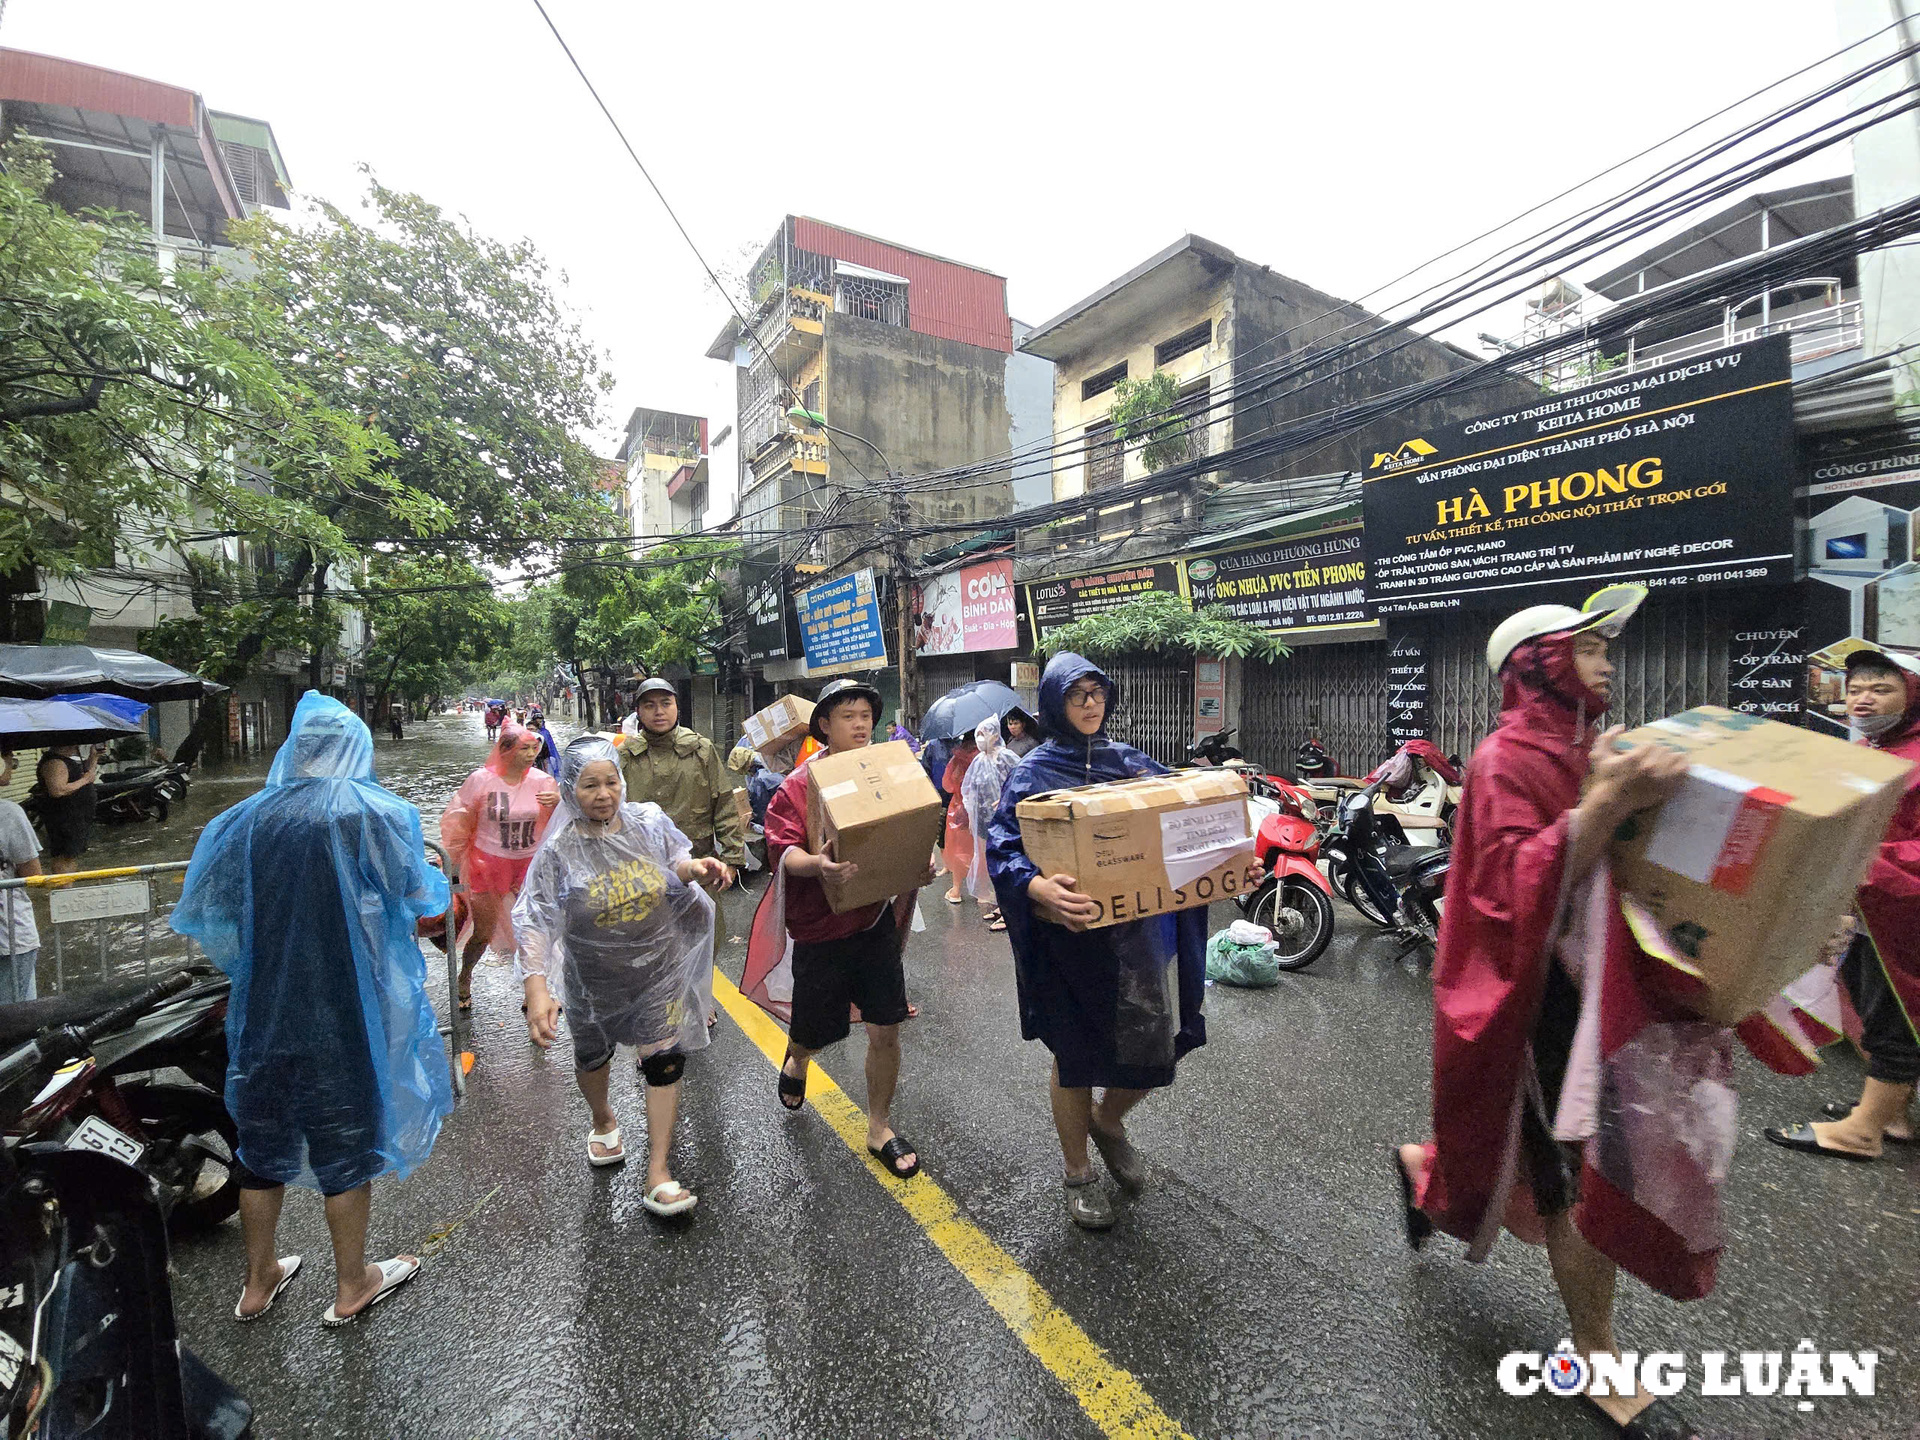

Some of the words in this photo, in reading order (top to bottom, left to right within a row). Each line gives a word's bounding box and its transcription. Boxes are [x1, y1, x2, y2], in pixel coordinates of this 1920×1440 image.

[1465, 418, 1499, 435] CÔNG
[1502, 412, 1519, 425] TY
[1521, 400, 1562, 420] TNHH
[1563, 384, 1630, 411] THƯƠNG
[1632, 373, 1665, 393] MẠI
[1668, 363, 1711, 381] DỊCH
[1714, 353, 1742, 369] VỤ
[1537, 411, 1584, 433] KEITA
[1586, 397, 1641, 420] HOME
[1416, 471, 1439, 484] VĂN
[1440, 462, 1482, 480] PHÒNG
[1483, 457, 1506, 471] ĐẠI
[1507, 449, 1540, 466] DIỆN
[1541, 436, 1595, 457] THÀNH
[1598, 424, 1631, 445] PHỐ
[1634, 420, 1660, 436] HÀ
[1663, 413, 1695, 431] NỘI
[1383, 461, 1403, 471] KEITA
[1404, 456, 1425, 466] HOME
[1815, 463, 1867, 479] CÔNG
[1437, 487, 1491, 525] HÀ
[1503, 457, 1664, 514] PHONG
[1406, 533, 1422, 545] TƯ
[1423, 528, 1448, 542] VẤN,
[1449, 522, 1483, 539] THIẾT
[1485, 517, 1504, 532] KẾ,
[1506, 516, 1529, 530] THI
[1531, 510, 1571, 525] CÔNG
[1573, 504, 1600, 518] NỘI
[1603, 494, 1644, 514] THẤT
[1647, 489, 1692, 506] TRỌN
[1694, 481, 1727, 498] GÓI
[1241, 552, 1272, 567] HÀNG
[1273, 543, 1321, 561] PHƯƠNG
[1324, 537, 1360, 554] HÙNG
[1378, 557, 1390, 566] THI
[1392, 553, 1417, 564] CÔNG
[1477, 540, 1506, 551] NANO
[1472, 555, 1497, 566] VÁCH
[1500, 550, 1536, 563] TRANG
[1538, 545, 1556, 557] TRÍ
[1559, 545, 1574, 555] TV
[1379, 580, 1407, 590] TRANH
[1408, 578, 1416, 587] IN
[1417, 577, 1428, 585] 3D
[1430, 573, 1460, 584] TRÁNG
[1462, 568, 1499, 580] GƯƠNG
[1500, 565, 1522, 575] CAO
[1546, 559, 1560, 570] VÀ
[1623, 549, 1642, 561] MỸ
[1644, 545, 1680, 558] NGHỆ
[1683, 539, 1733, 554] DECOR
[968, 571, 1006, 600] CƠM
[1215, 575, 1237, 599] ỐNG
[1237, 573, 1269, 599] NHỰA
[1269, 571, 1292, 592] PVC
[1292, 561, 1321, 588] TIỀN
[1322, 561, 1366, 585] PHONG
[1649, 578, 1667, 587] 841
[1669, 576, 1688, 585] 412
[1697, 572, 1722, 583] 0911
[1724, 570, 1744, 580] 041
[1744, 567, 1768, 578] 369
[1036, 586, 1059, 600] LOTUS
[963, 602, 988, 618] BÌNH
[990, 597, 1014, 614] DÂN
[1263, 603, 1268, 614] &
[1735, 628, 1799, 641] CHUYÊN
[1392, 649, 1404, 657] TƯ
[1405, 646, 1421, 656] VẤN
[1762, 651, 1803, 665] TRẦN
[1391, 664, 1413, 674] THIẾT
[1403, 683, 1426, 691] CÔNG
[1761, 701, 1800, 712] VÁCH
